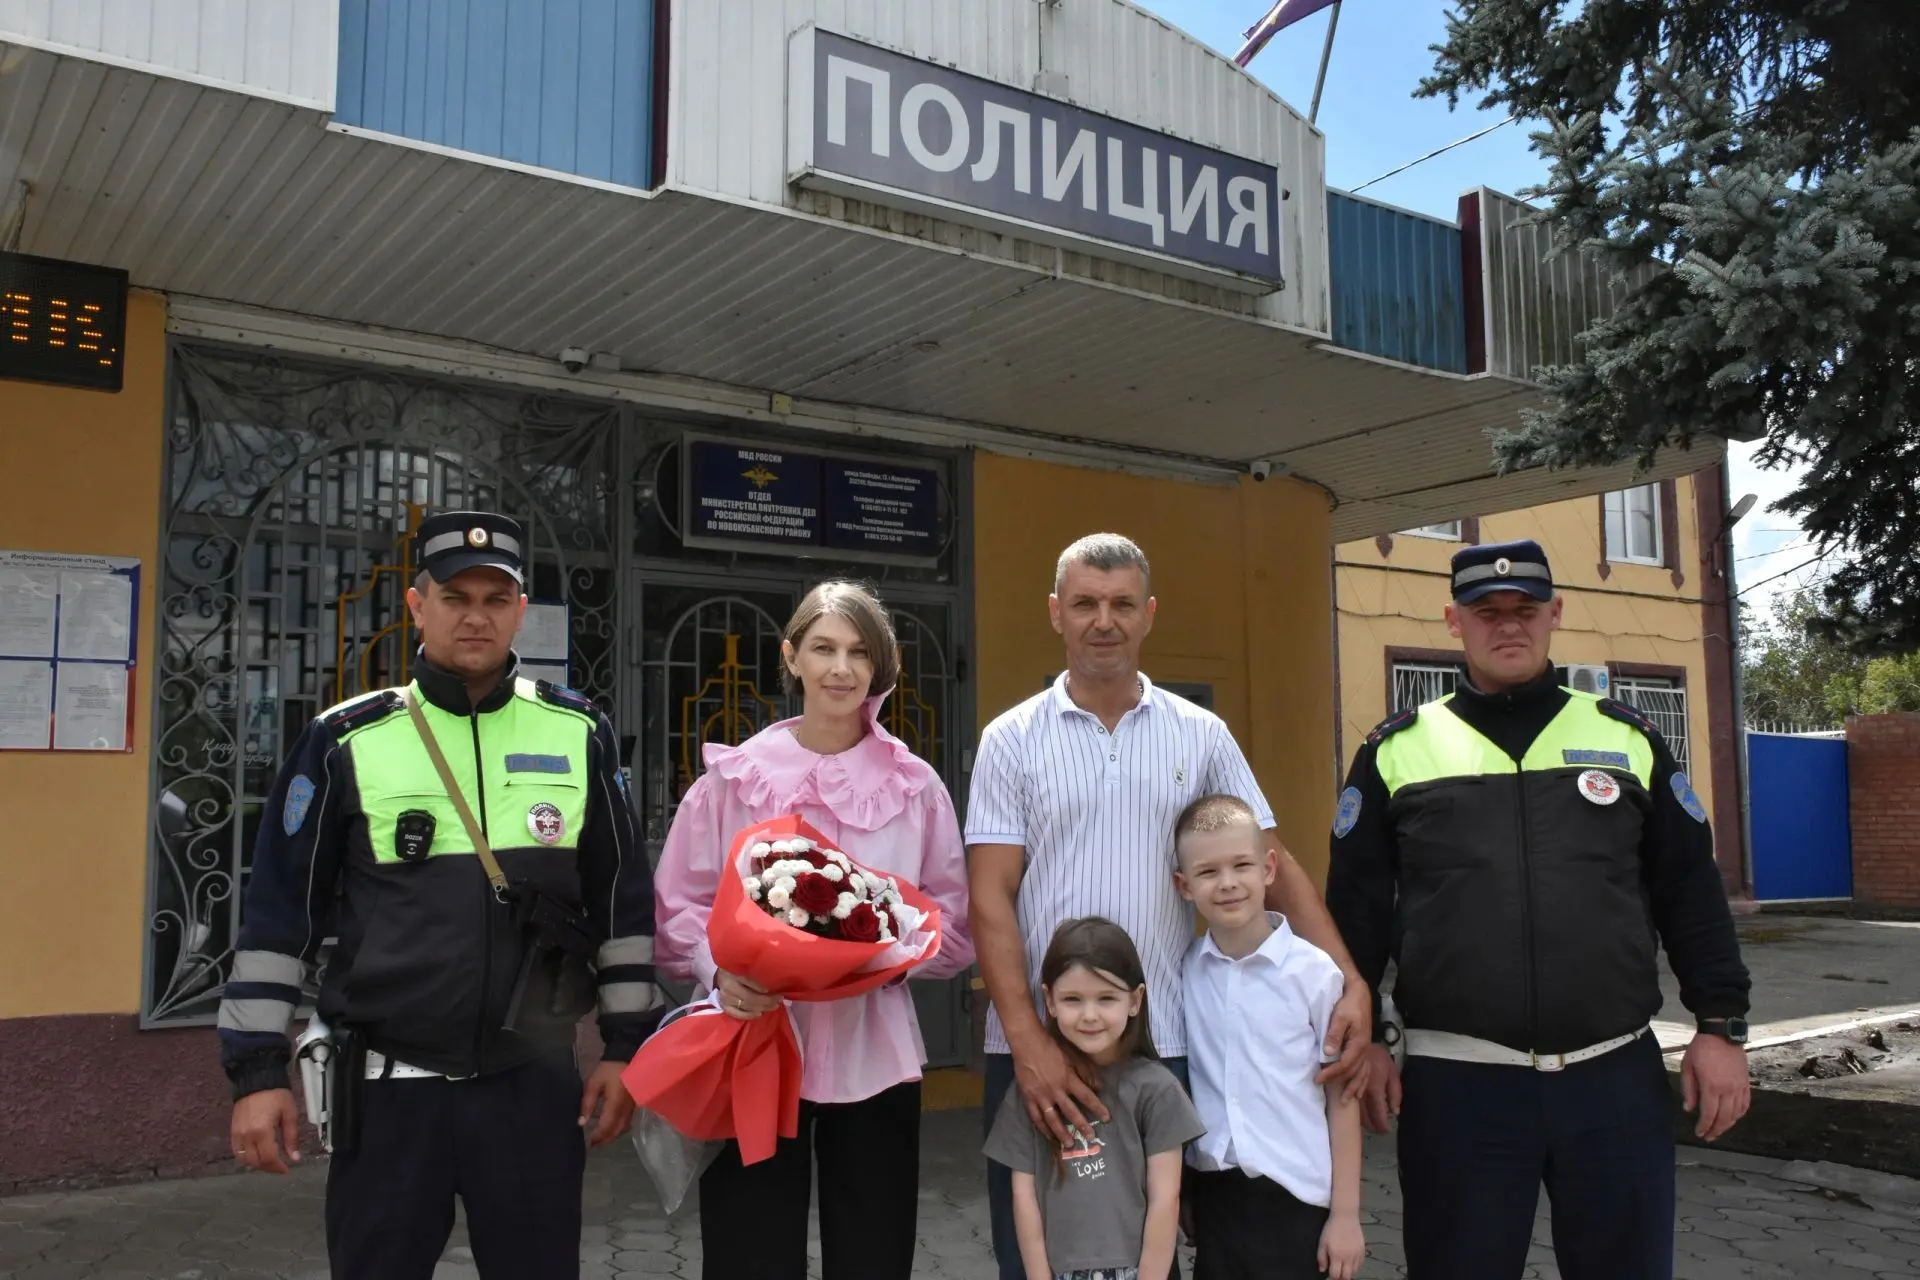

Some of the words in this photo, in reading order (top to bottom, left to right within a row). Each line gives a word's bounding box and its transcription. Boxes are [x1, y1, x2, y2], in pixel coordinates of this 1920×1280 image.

[826, 53, 1271, 257] ПОЛИЦИЯ
[738, 450, 754, 460] МВД
[756, 453, 782, 463] РОССИИ
[748, 491, 771, 501] ОТДЕЛ
[702, 497, 757, 511] МИНИСТЕРСТВА
[758, 502, 801, 516] ВНУТРЕННИХ
[802, 508, 816, 517] ДЕЛ
[714, 509, 761, 522] РОССИЙСКОЙ
[762, 515, 804, 526] ФЕДЕРАЦИИ
[707, 520, 717, 530] ПО
[718, 521, 784, 536] НОВОКУБАНСКОМУ
[785, 527, 811, 538] РАЙОНУ
[1076, 1157, 1106, 1177] LOVE
